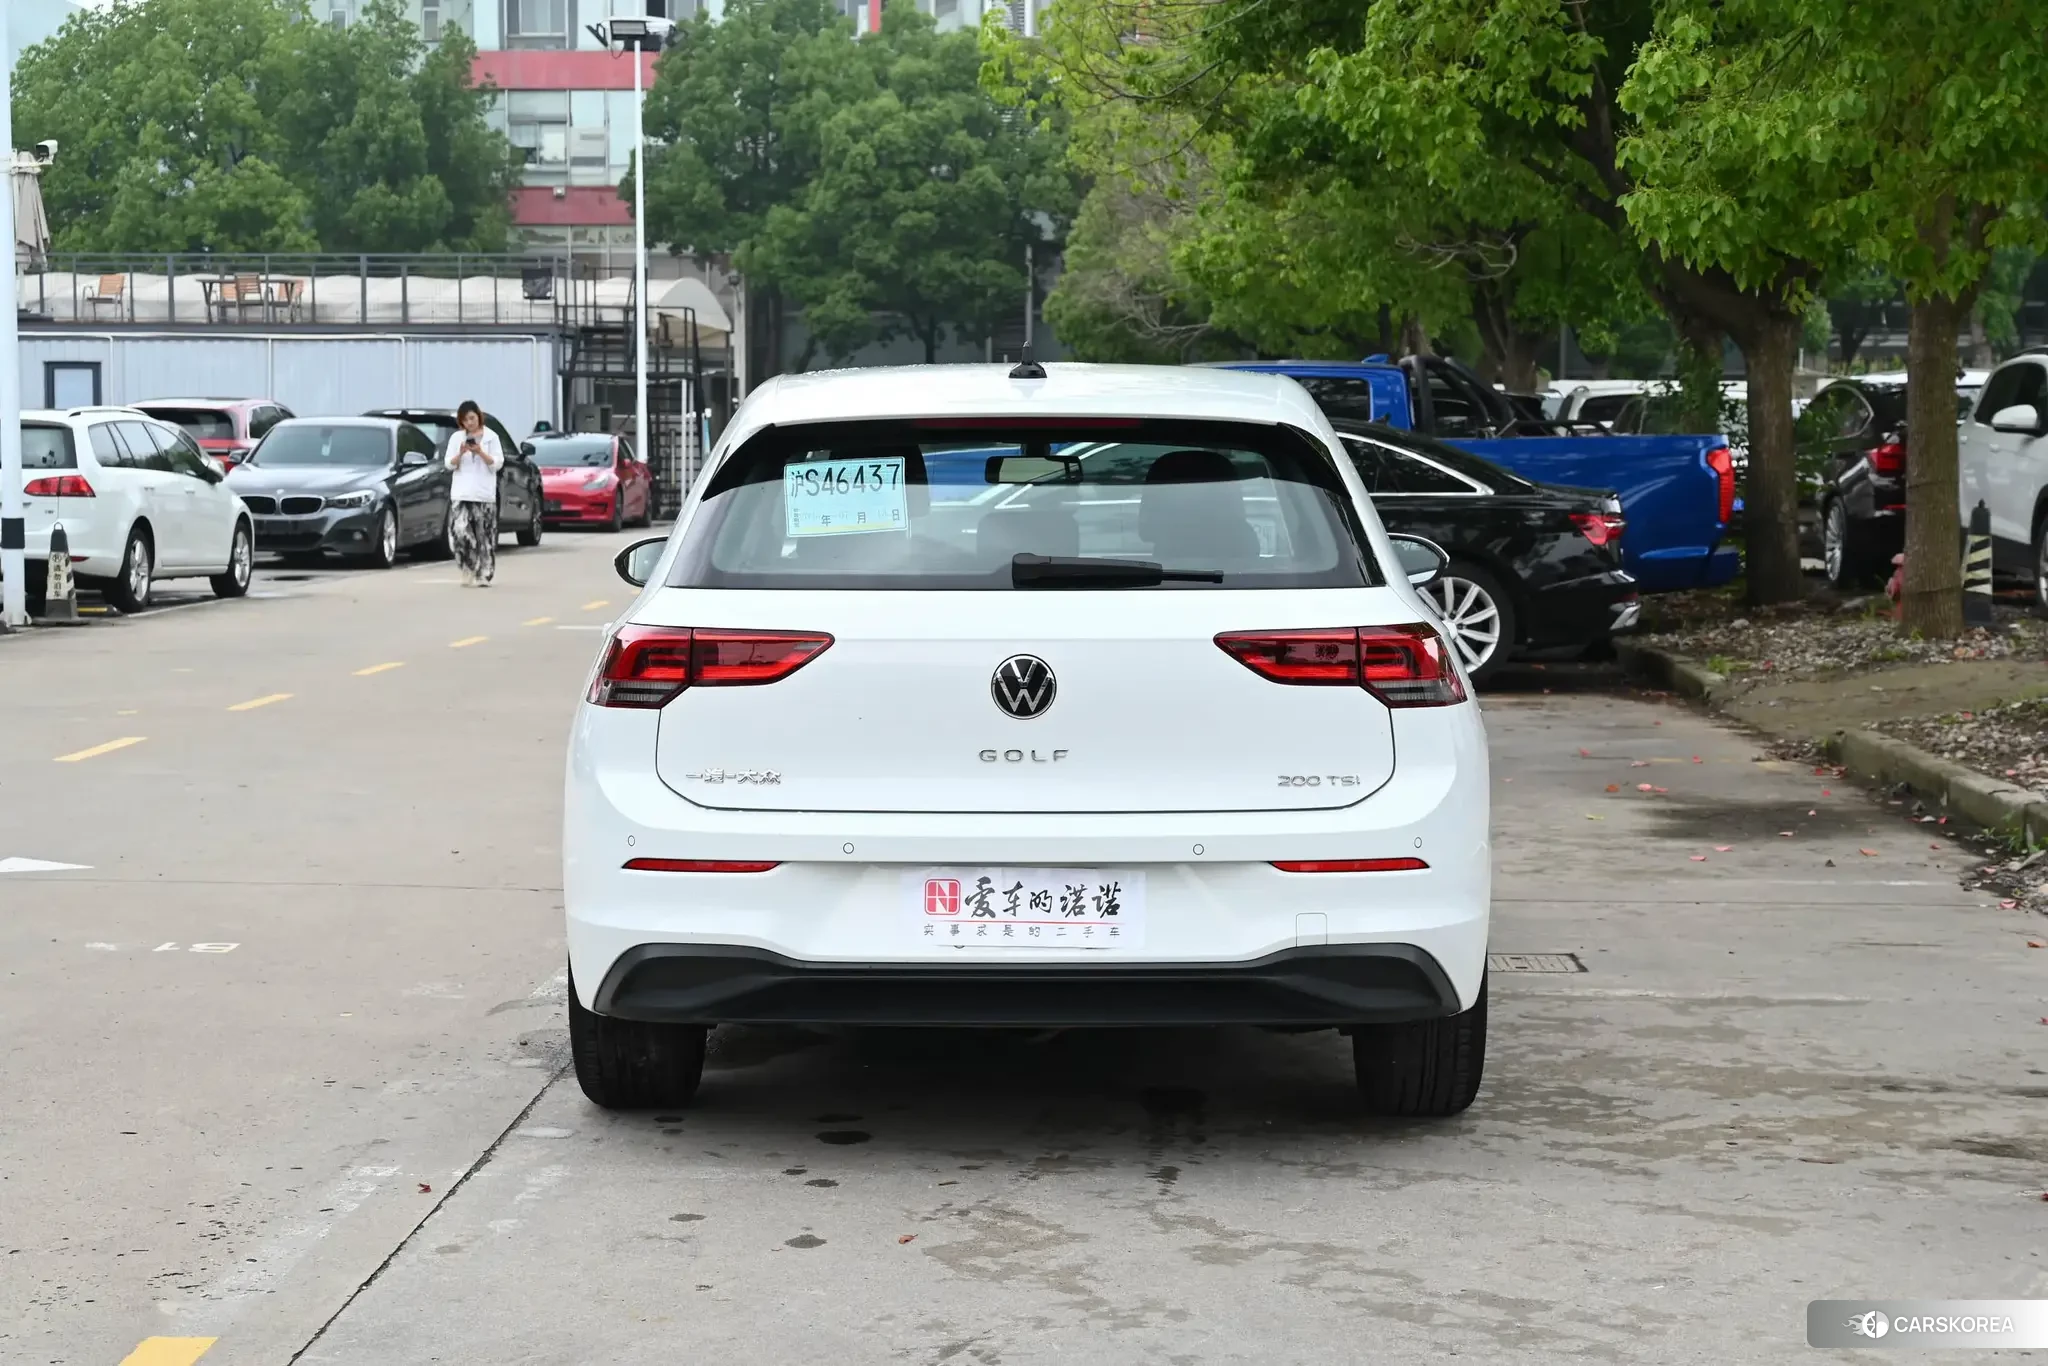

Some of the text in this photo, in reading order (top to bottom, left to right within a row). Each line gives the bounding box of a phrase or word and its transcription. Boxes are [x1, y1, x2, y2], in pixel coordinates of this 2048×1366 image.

[790, 463, 901, 498] 沪S46437
[857, 512, 866, 524] 月
[978, 749, 1069, 762] GOLF
[1277, 775, 1321, 787] 200
[923, 924, 1121, 938] 实事求是的二手车
